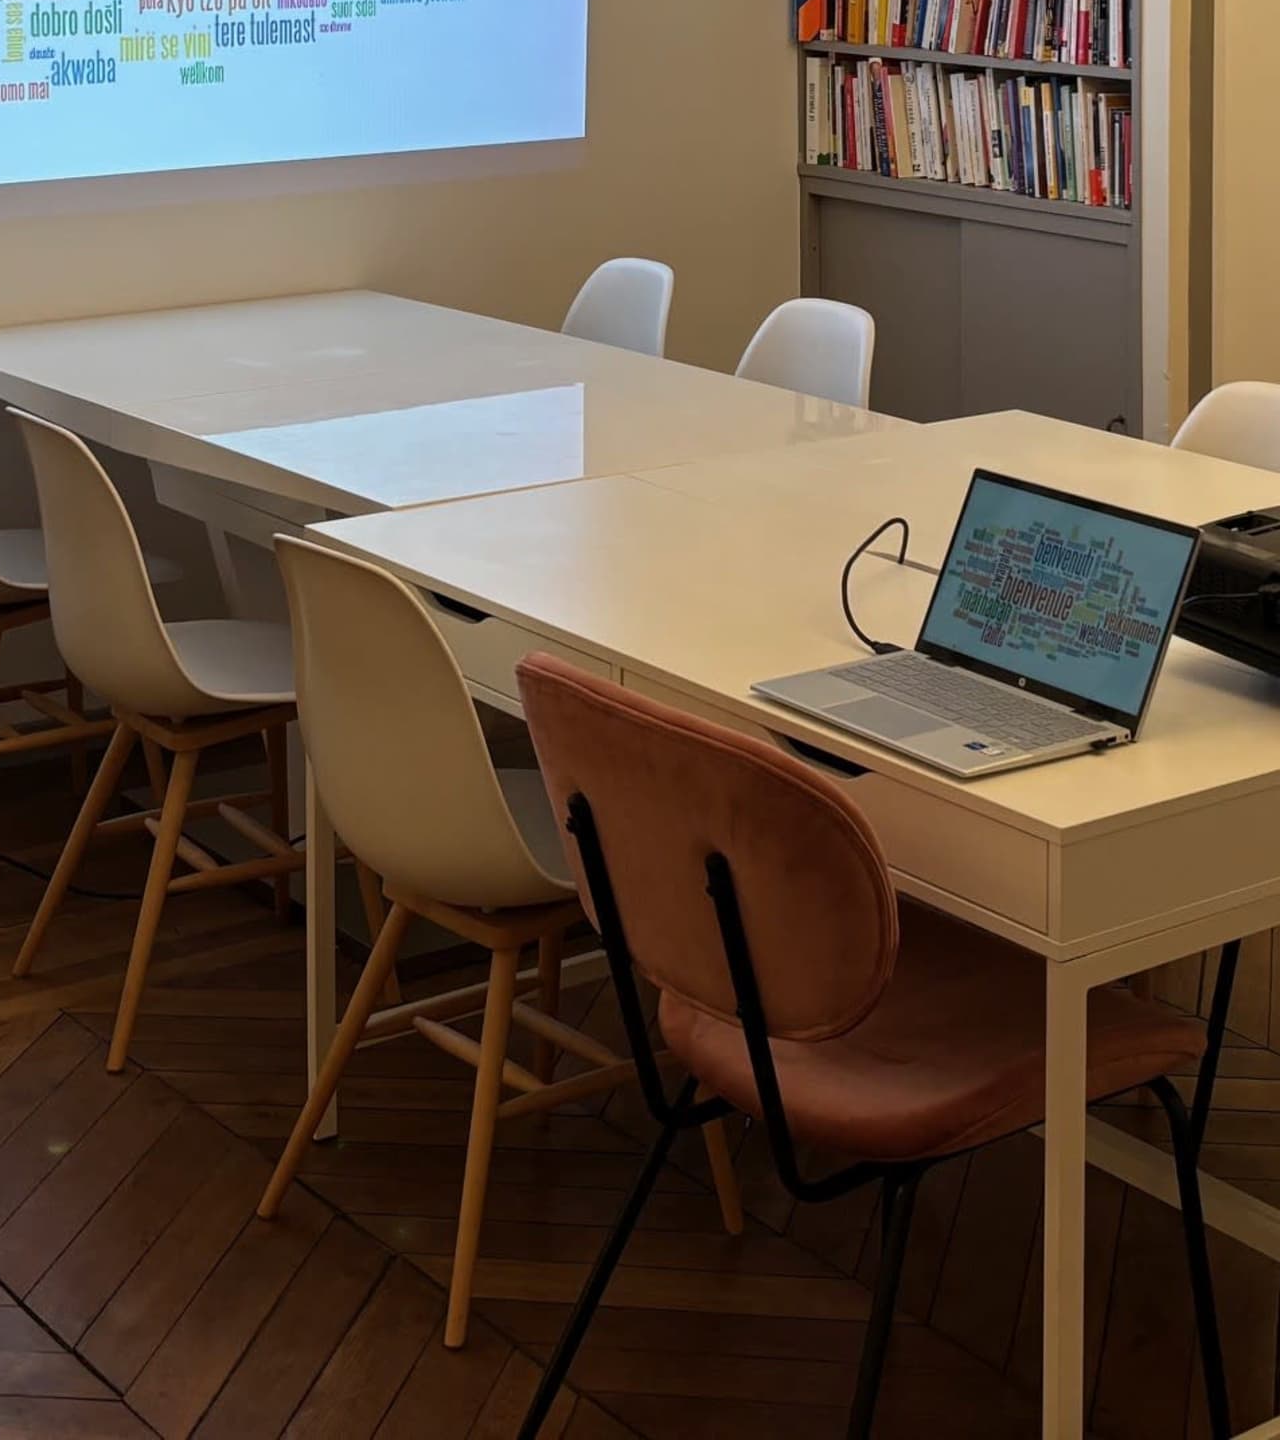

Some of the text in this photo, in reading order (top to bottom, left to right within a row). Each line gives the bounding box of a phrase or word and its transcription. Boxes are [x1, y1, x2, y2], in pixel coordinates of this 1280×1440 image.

[31, 0, 123, 38] dobro došli
[331, 0, 354, 19] suor
[161, 34, 179, 59] se
[183, 24, 212, 59] vini
[215, 10, 316, 48] tere tulemast
[51, 49, 116, 87] akwaba
[28, 75, 50, 101] mai
[1034, 534, 1097, 578] benvenuti
[1000, 566, 1074, 621] bienvenue
[1079, 621, 1124, 654] welcome
